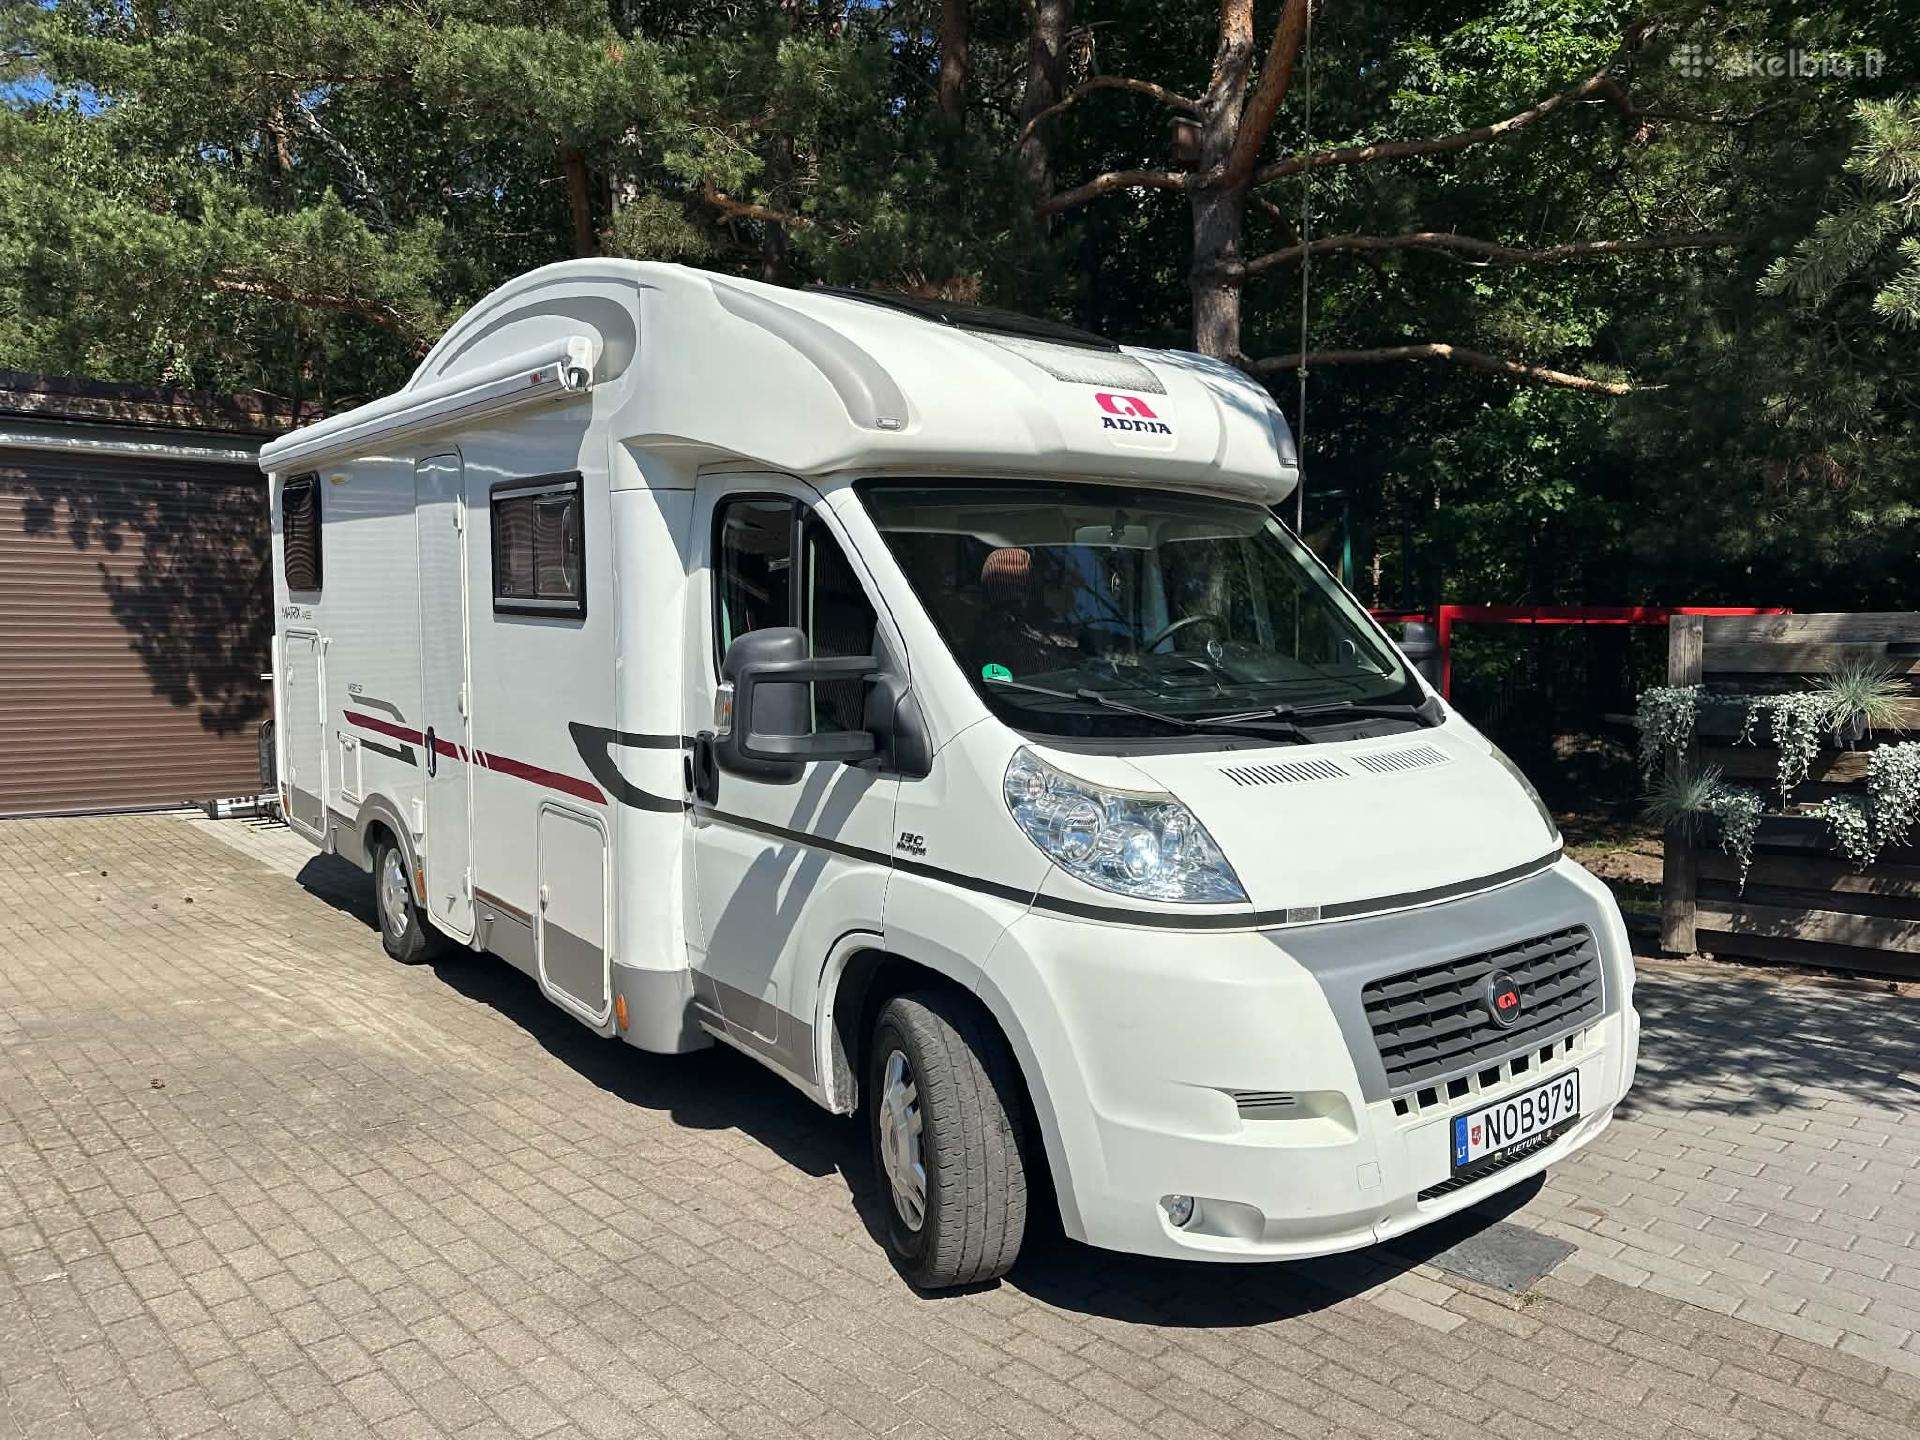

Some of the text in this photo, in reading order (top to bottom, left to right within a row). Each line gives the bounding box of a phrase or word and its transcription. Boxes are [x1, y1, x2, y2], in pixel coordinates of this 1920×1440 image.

[1101, 416, 1172, 434] ADRIA
[1484, 1079, 1574, 1149] NOB979
[1507, 1135, 1542, 1156] LIETUVA
